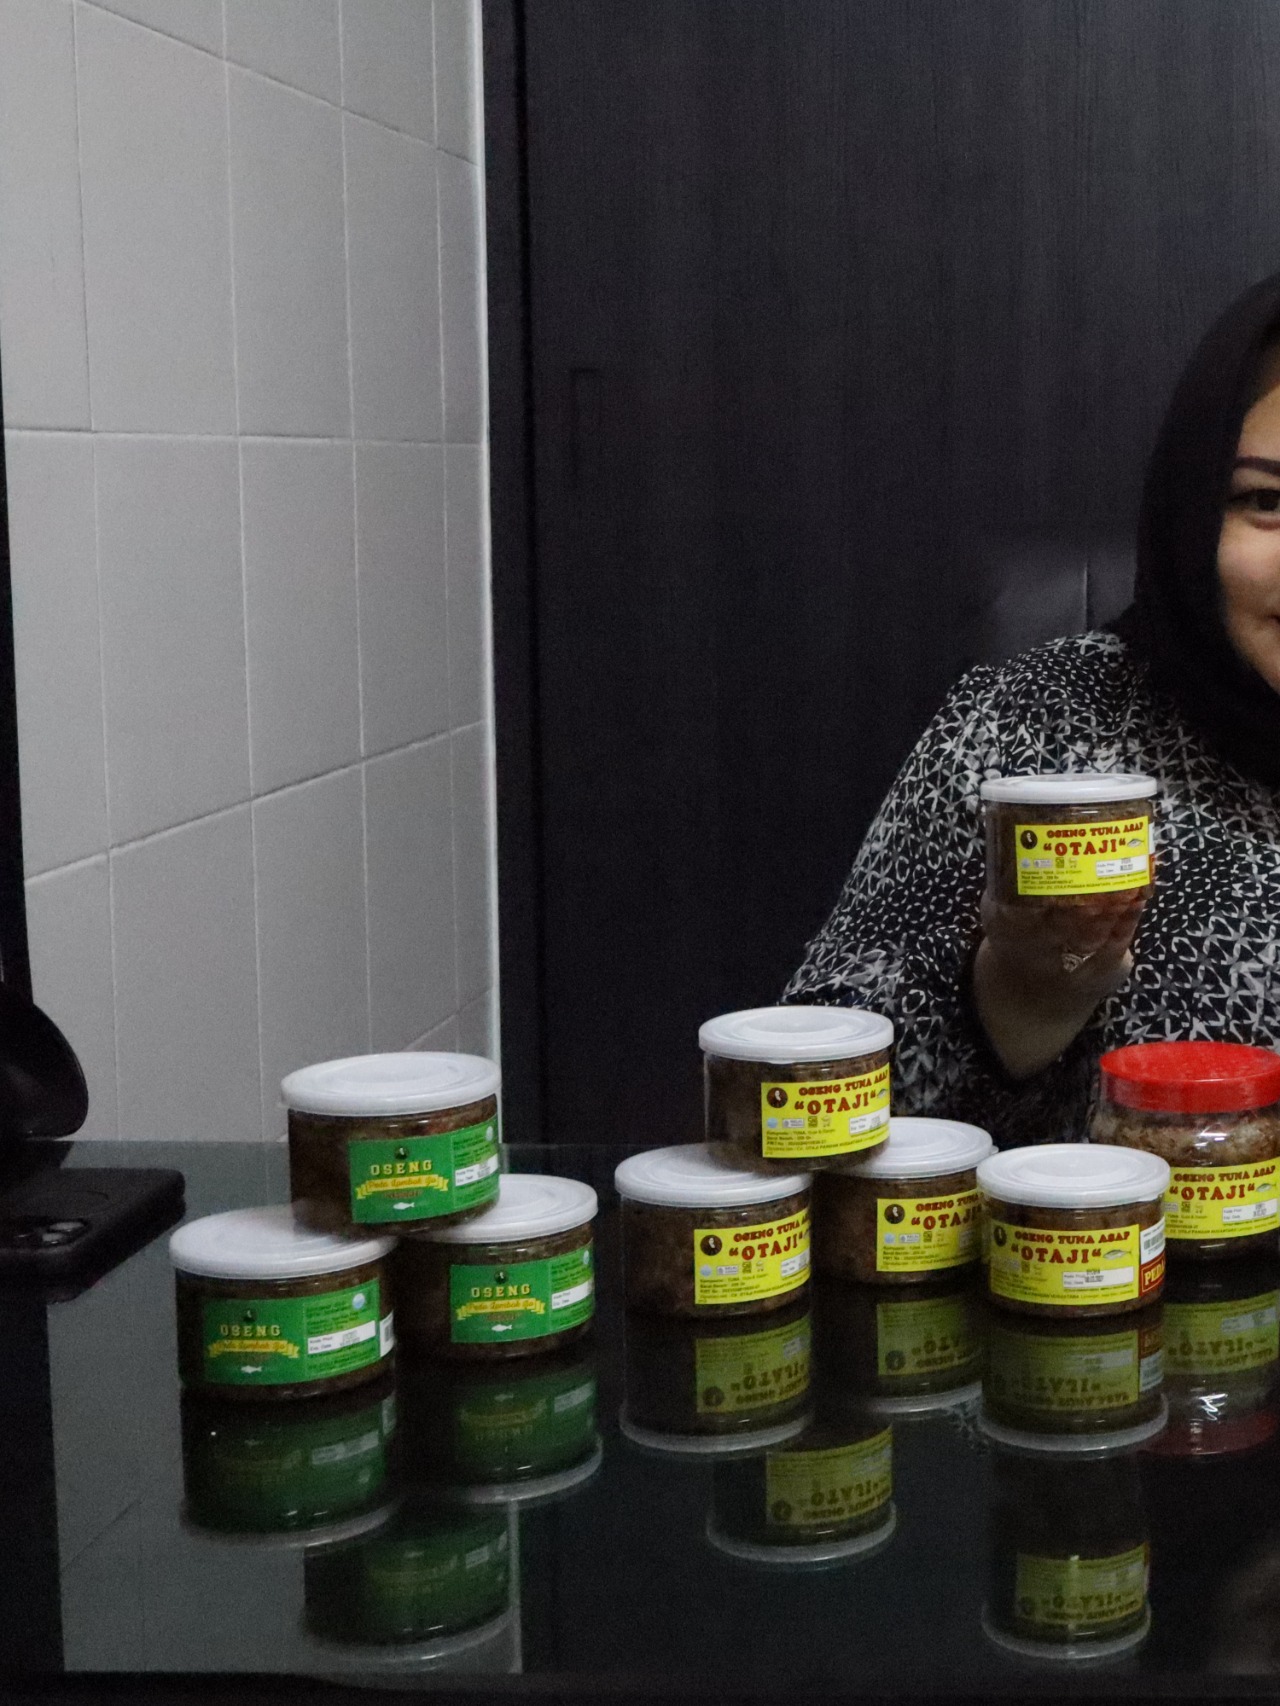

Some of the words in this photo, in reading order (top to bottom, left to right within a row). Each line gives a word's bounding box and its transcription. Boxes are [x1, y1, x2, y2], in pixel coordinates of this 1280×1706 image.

[1046, 828, 1087, 839] OSENG
[1089, 826, 1121, 837] TUNA
[1123, 821, 1144, 833] ASAP
[798, 1084, 842, 1096] OSENG
[844, 1078, 872, 1091] TUNA
[370, 1159, 433, 1176] OSENG
[1218, 1171, 1251, 1182] TUNA
[733, 1227, 775, 1242] OSENG
[776, 1219, 800, 1235] TUNA
[1014, 1230, 1054, 1243] OSENG
[1057, 1235, 1095, 1245] TUNA
[1098, 1231, 1130, 1244] ASAP
[471, 1283, 531, 1298] OSENG
[219, 1324, 281, 1337] OSENG
